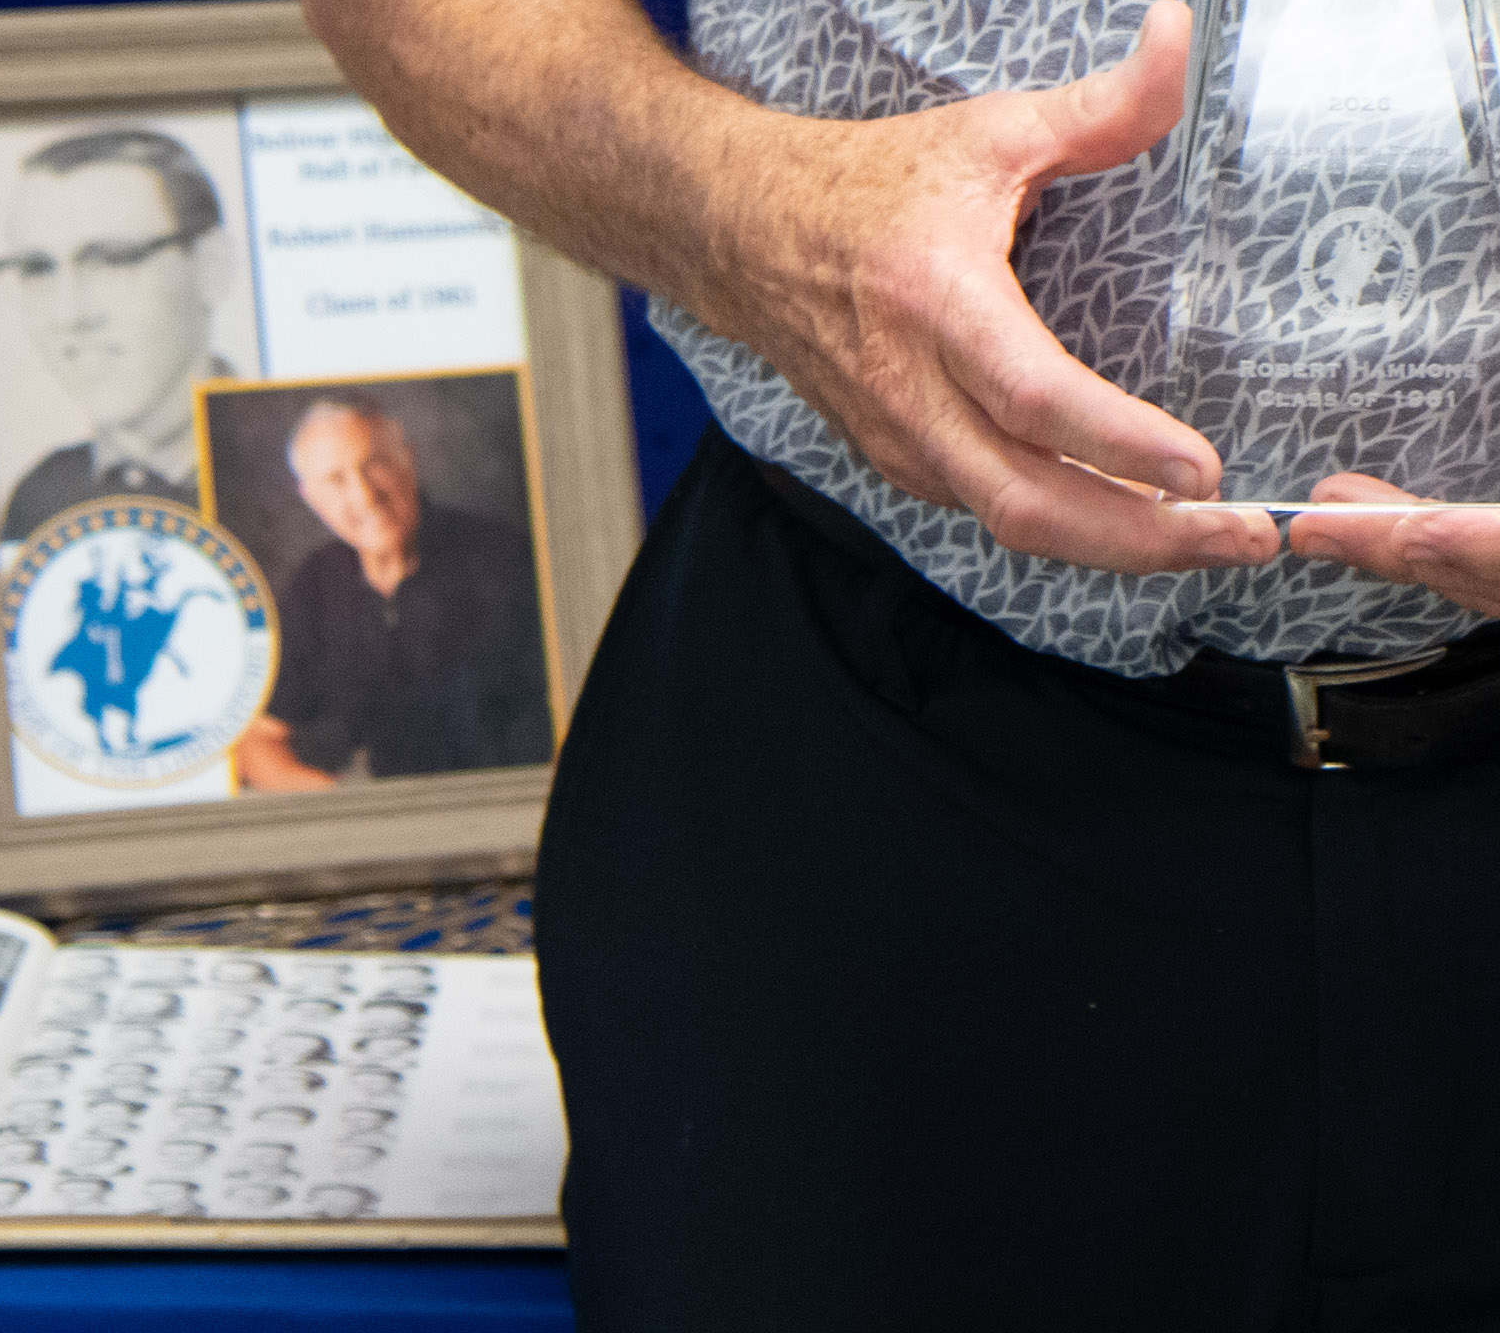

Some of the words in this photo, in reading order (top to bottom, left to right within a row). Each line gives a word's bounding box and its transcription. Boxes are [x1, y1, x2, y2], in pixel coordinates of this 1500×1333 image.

[1328, 95, 1392, 113] 2026
[387, 288, 412, 311] of
[1238, 359, 1341, 379] ROBERT
[1352, 361, 1479, 379] HAMMONS
[1255, 389, 1338, 408] CLASS
[1348, 392, 1381, 408] OF
[1395, 389, 1457, 408] 1961
